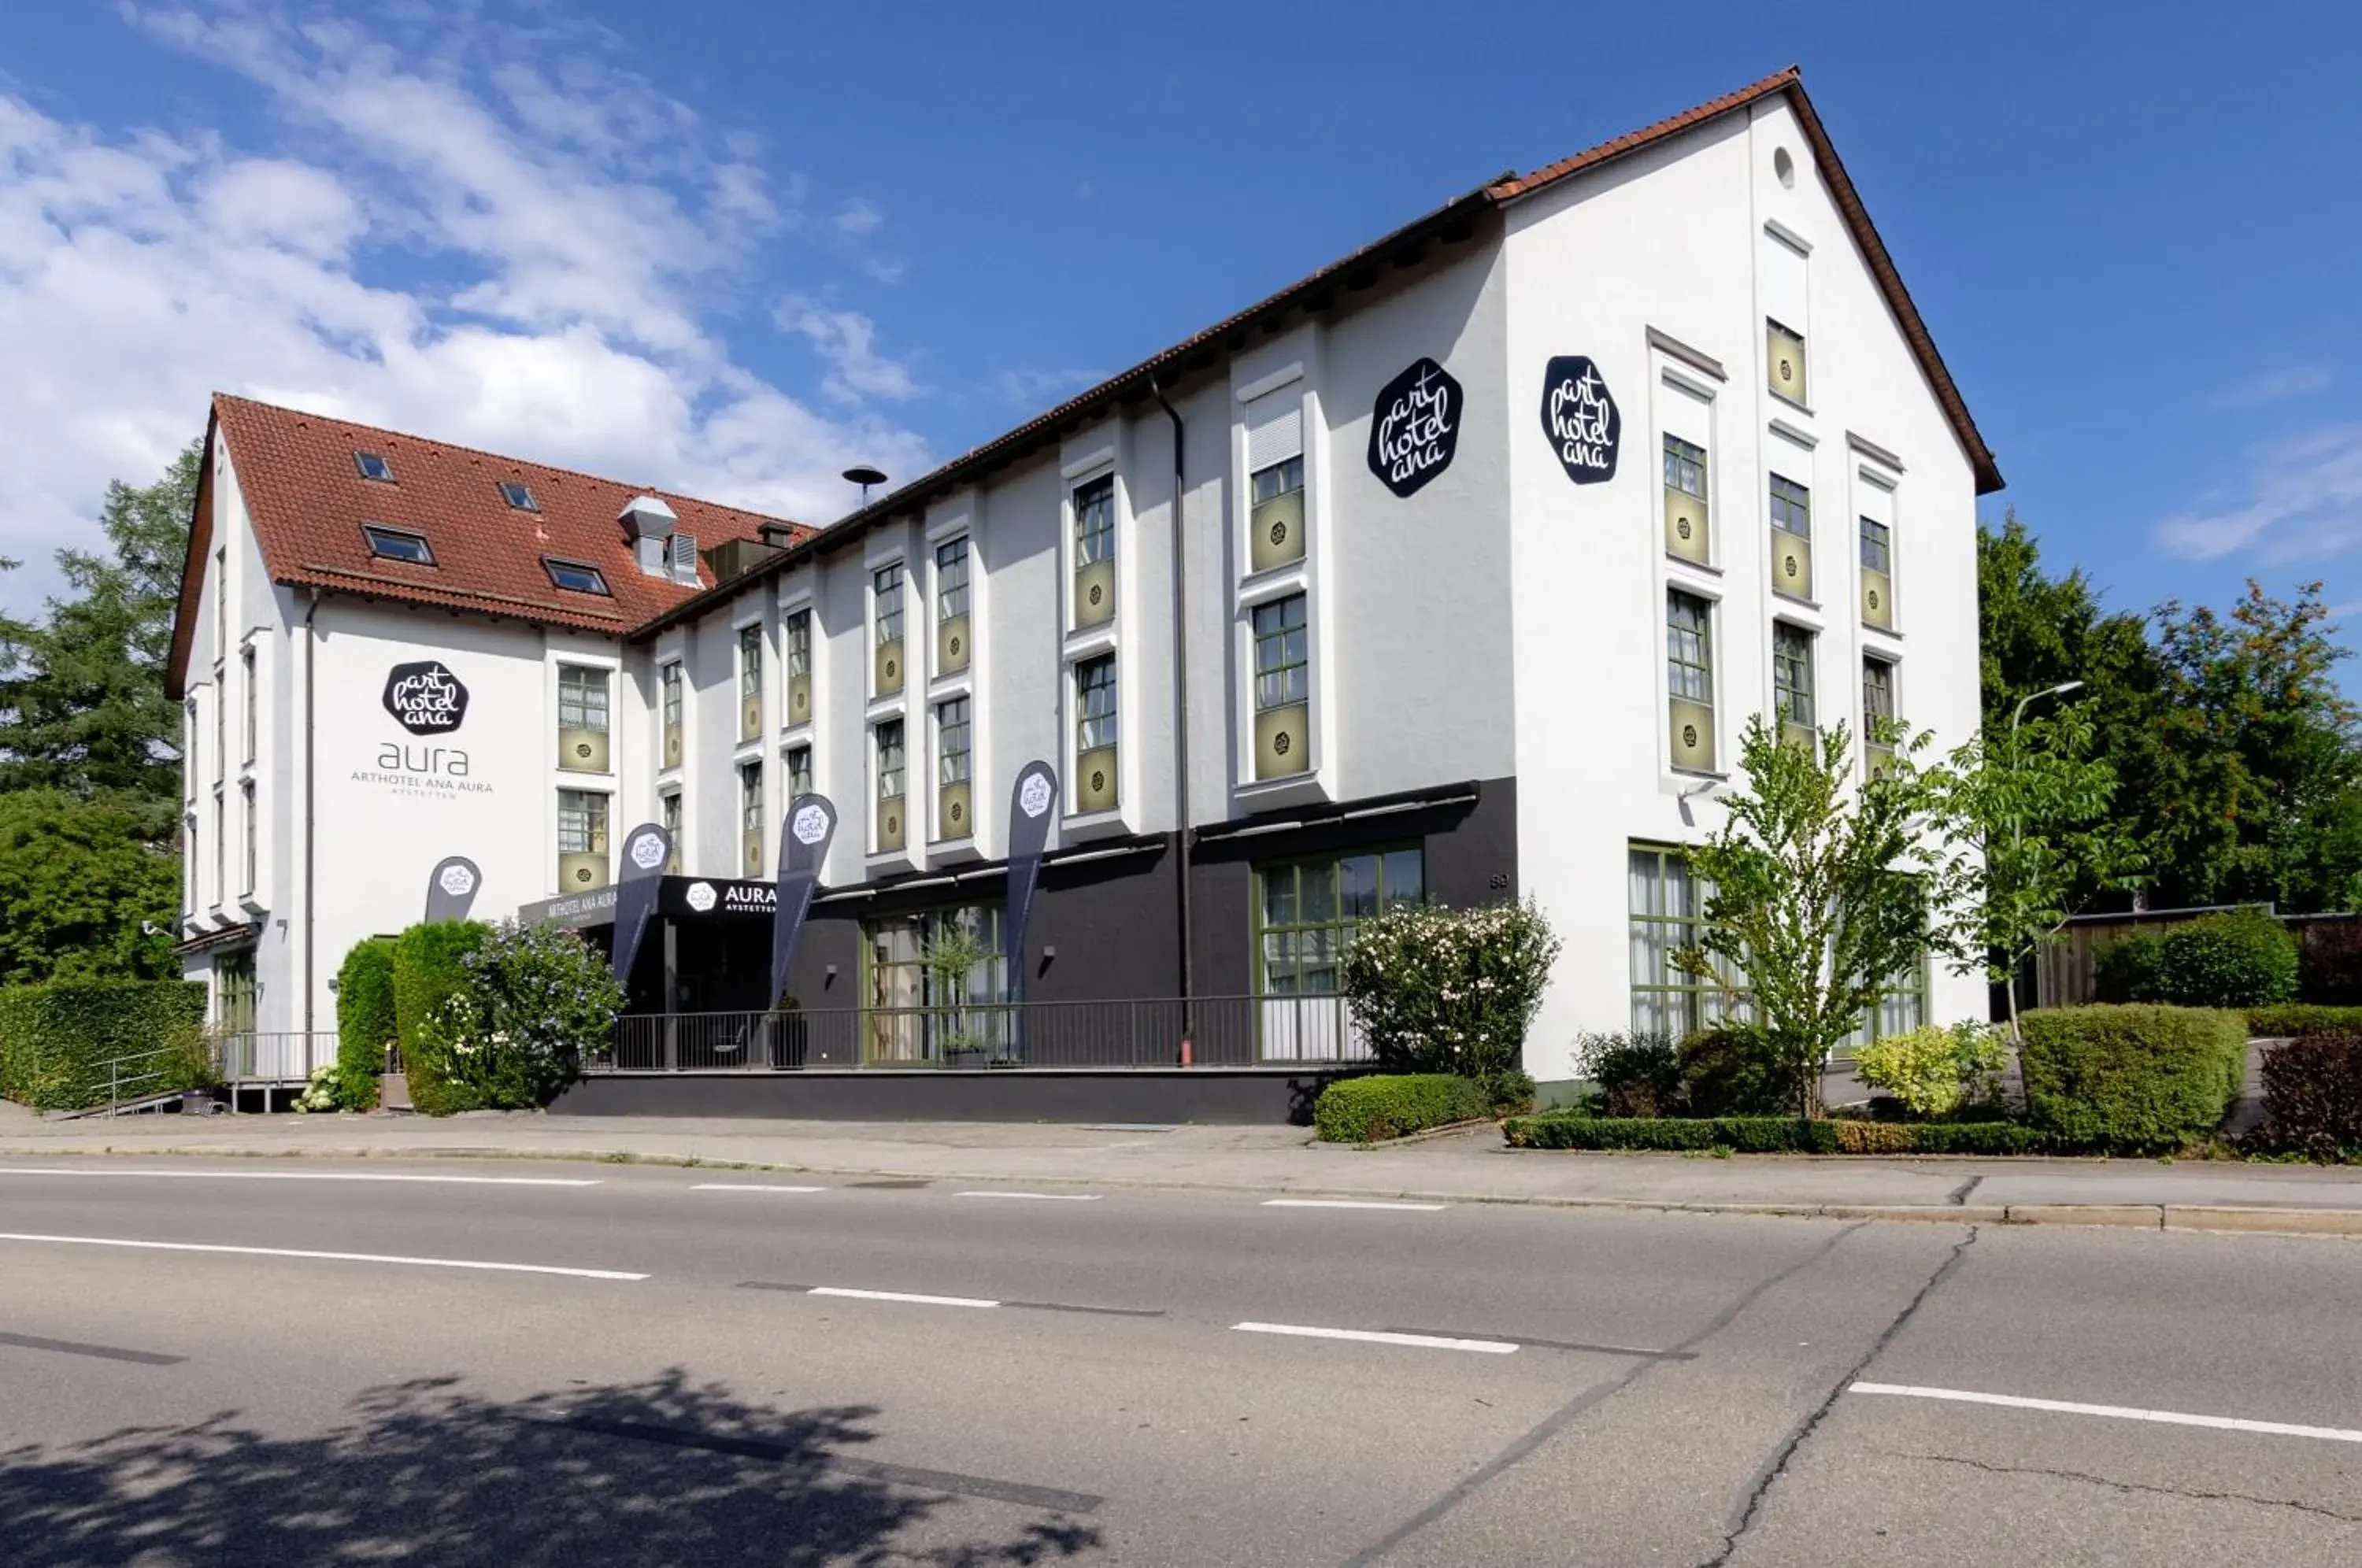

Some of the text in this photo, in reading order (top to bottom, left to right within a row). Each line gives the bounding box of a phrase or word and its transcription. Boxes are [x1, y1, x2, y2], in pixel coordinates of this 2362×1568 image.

[1391, 365, 1442, 422] art
[1562, 364, 1604, 407] art
[1379, 386, 1453, 466] hotel
[1550, 388, 1612, 446] hotel
[1391, 441, 1446, 483] ana
[1563, 440, 1609, 468] ana
[406, 665, 451, 689] art
[394, 682, 459, 711] hotel
[404, 711, 453, 725] ana
[378, 742, 468, 776] aura
[350, 771, 494, 793] ARTHOTEL ANA AURA
[725, 886, 777, 903] AURA
